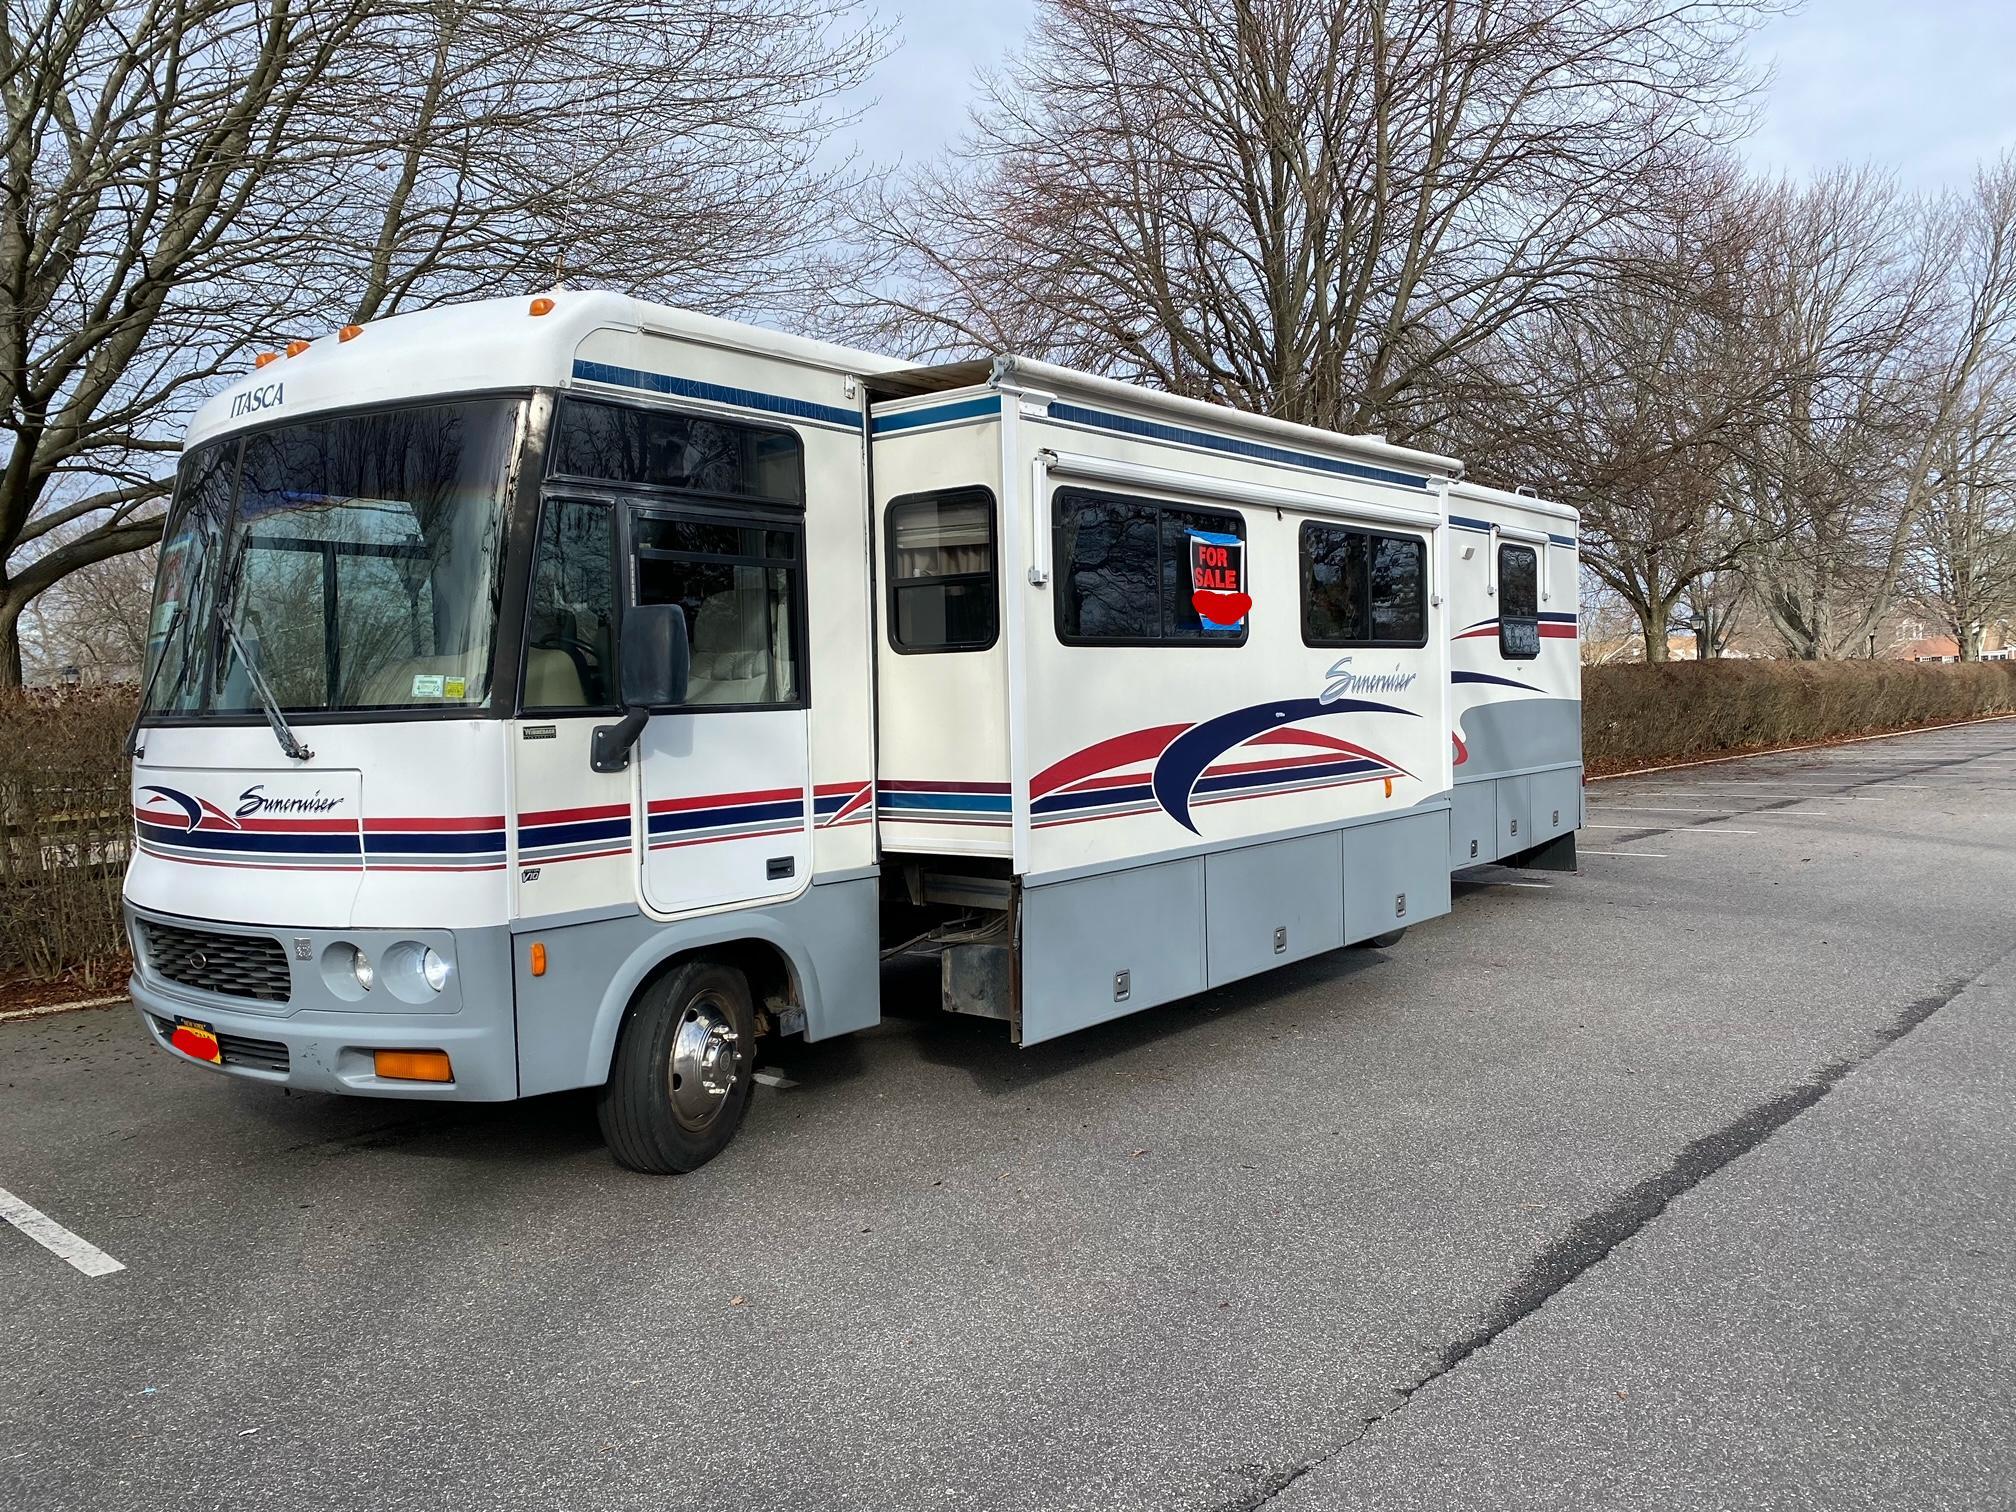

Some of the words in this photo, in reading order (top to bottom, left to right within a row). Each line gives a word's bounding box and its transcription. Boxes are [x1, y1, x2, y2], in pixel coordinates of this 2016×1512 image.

[230, 382, 284, 418] ITASCA
[1198, 546, 1227, 567] FOR
[1194, 567, 1237, 589] SALE
[235, 785, 344, 818] Suncruiser
[521, 872, 539, 882] V10
